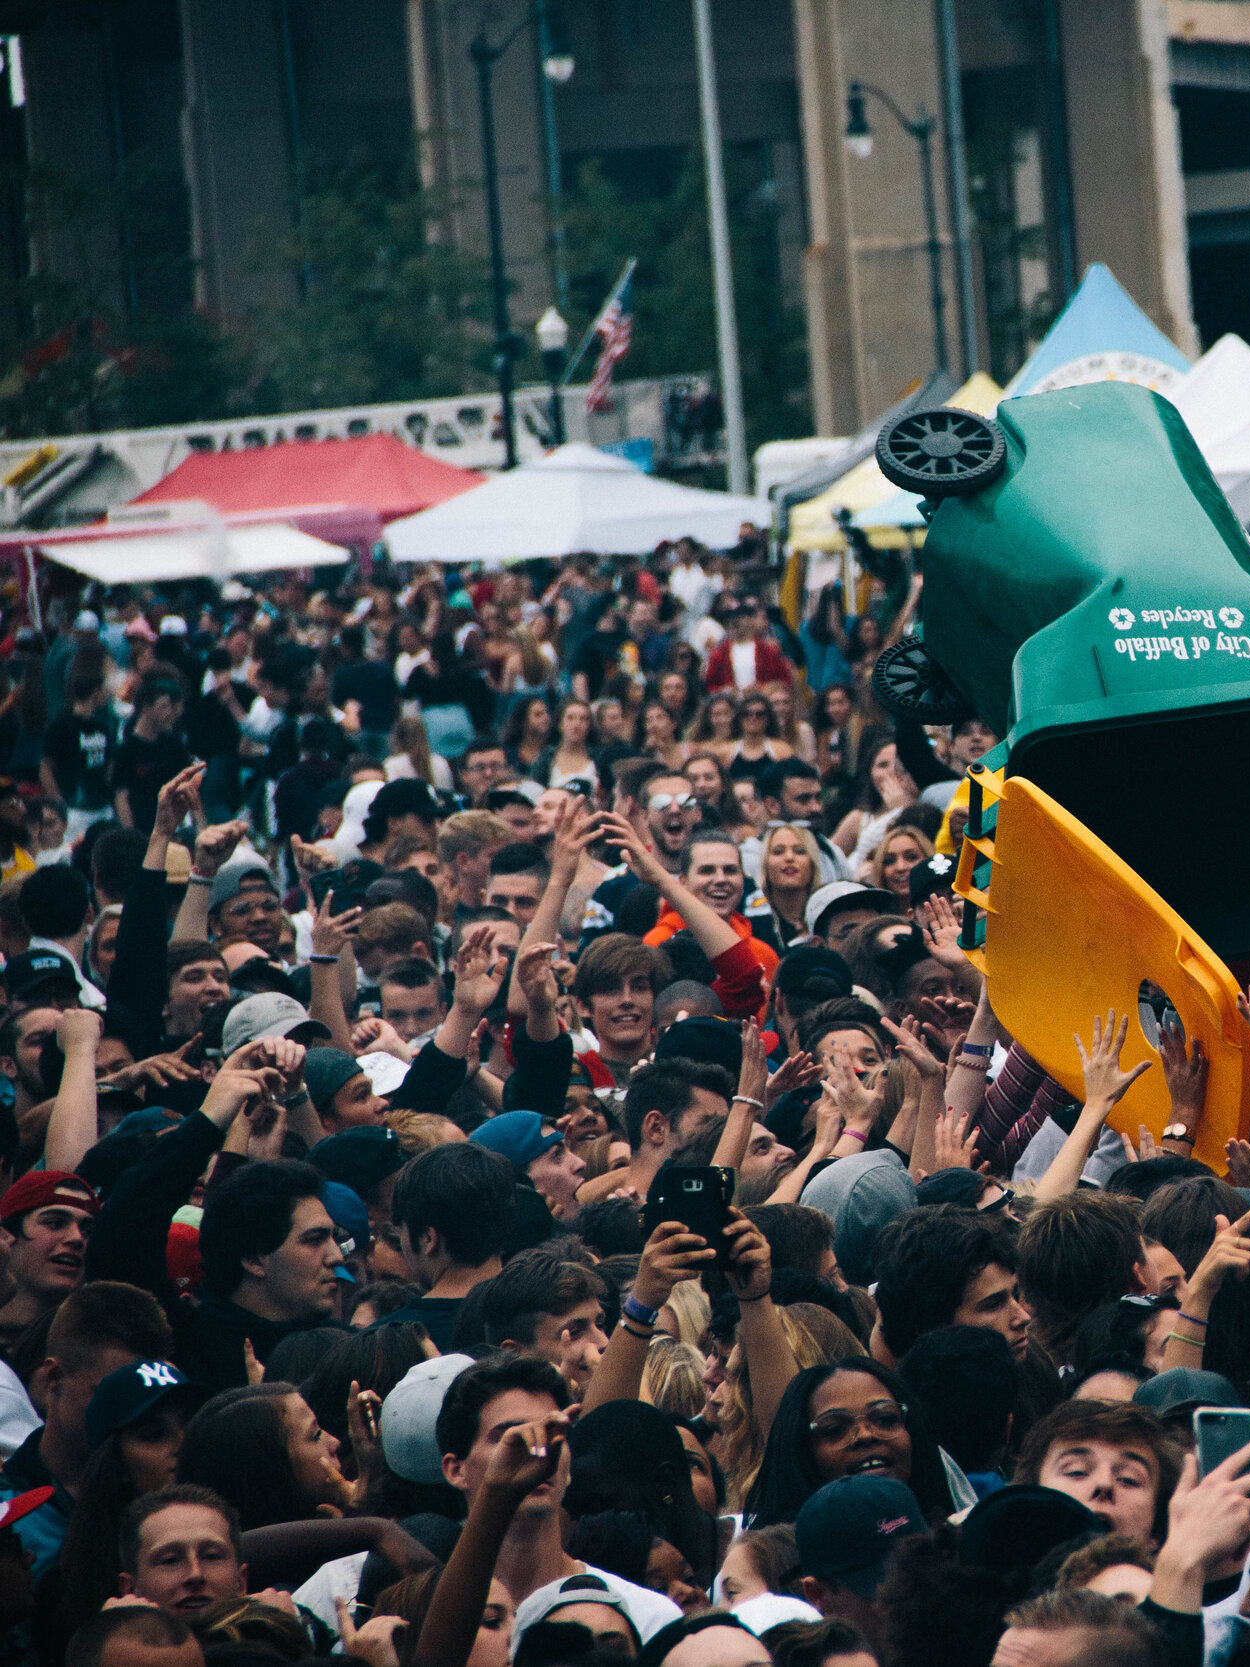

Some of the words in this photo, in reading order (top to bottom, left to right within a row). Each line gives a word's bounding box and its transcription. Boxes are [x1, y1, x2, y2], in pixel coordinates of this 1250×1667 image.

[1140, 606, 1218, 630] Recycles
[1114, 636, 1190, 662] Buffalo
[1191, 636, 1211, 660] of
[136, 1361, 178, 1387] NY
